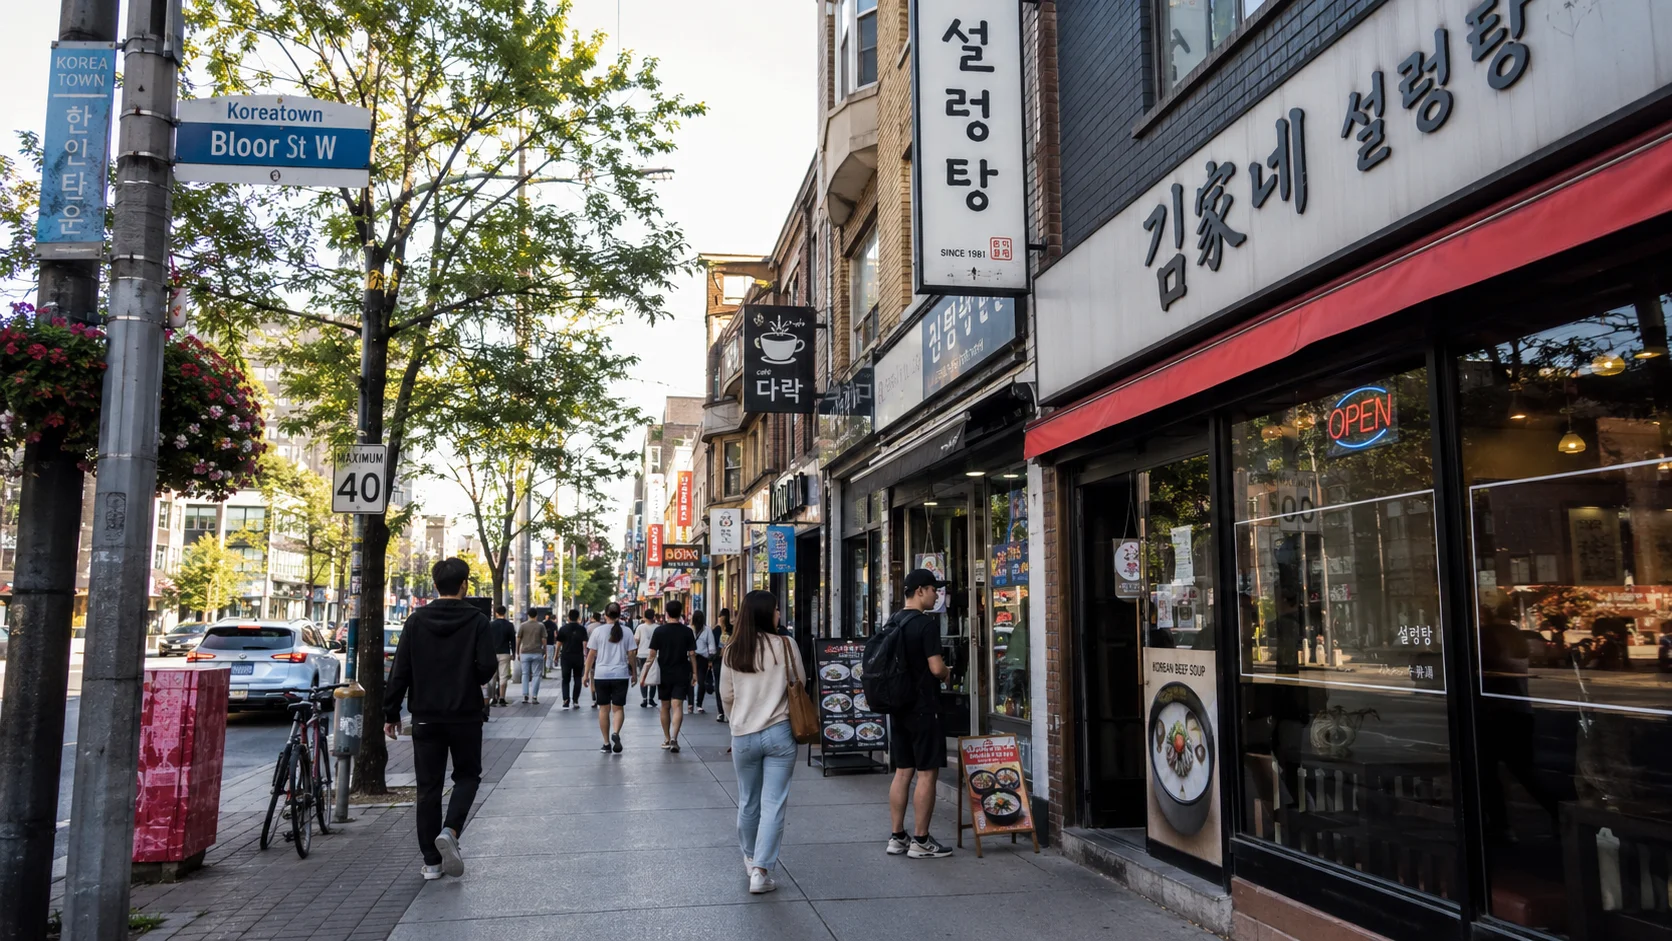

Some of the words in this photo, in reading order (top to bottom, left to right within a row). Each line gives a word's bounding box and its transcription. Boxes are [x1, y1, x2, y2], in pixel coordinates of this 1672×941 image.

[56, 56, 108, 71] KOREA
[57, 73, 105, 87] TOWN
[227, 101, 323, 124] Koreatown
[942, 18, 999, 212] 설렁탕
[211, 130, 279, 158] Bloor
[286, 135, 306, 159] St
[315, 135, 337, 160] W
[1142, 107, 1309, 312] 김家네
[1340, 0, 1532, 172] 설렁탕
[940, 248, 965, 257] SINCE
[968, 250, 986, 259] 1981
[756, 377, 804, 404] 다락
[1328, 393, 1393, 440] OPEN
[337, 452, 383, 464] MAXIMUM
[337, 472, 381, 503] 40
[1397, 624, 1433, 646] 설렁탕
[1152, 661, 1174, 674] KOREAN
[1175, 663, 1189, 675] BEEF
[1189, 664, 1206, 677] SOUP
